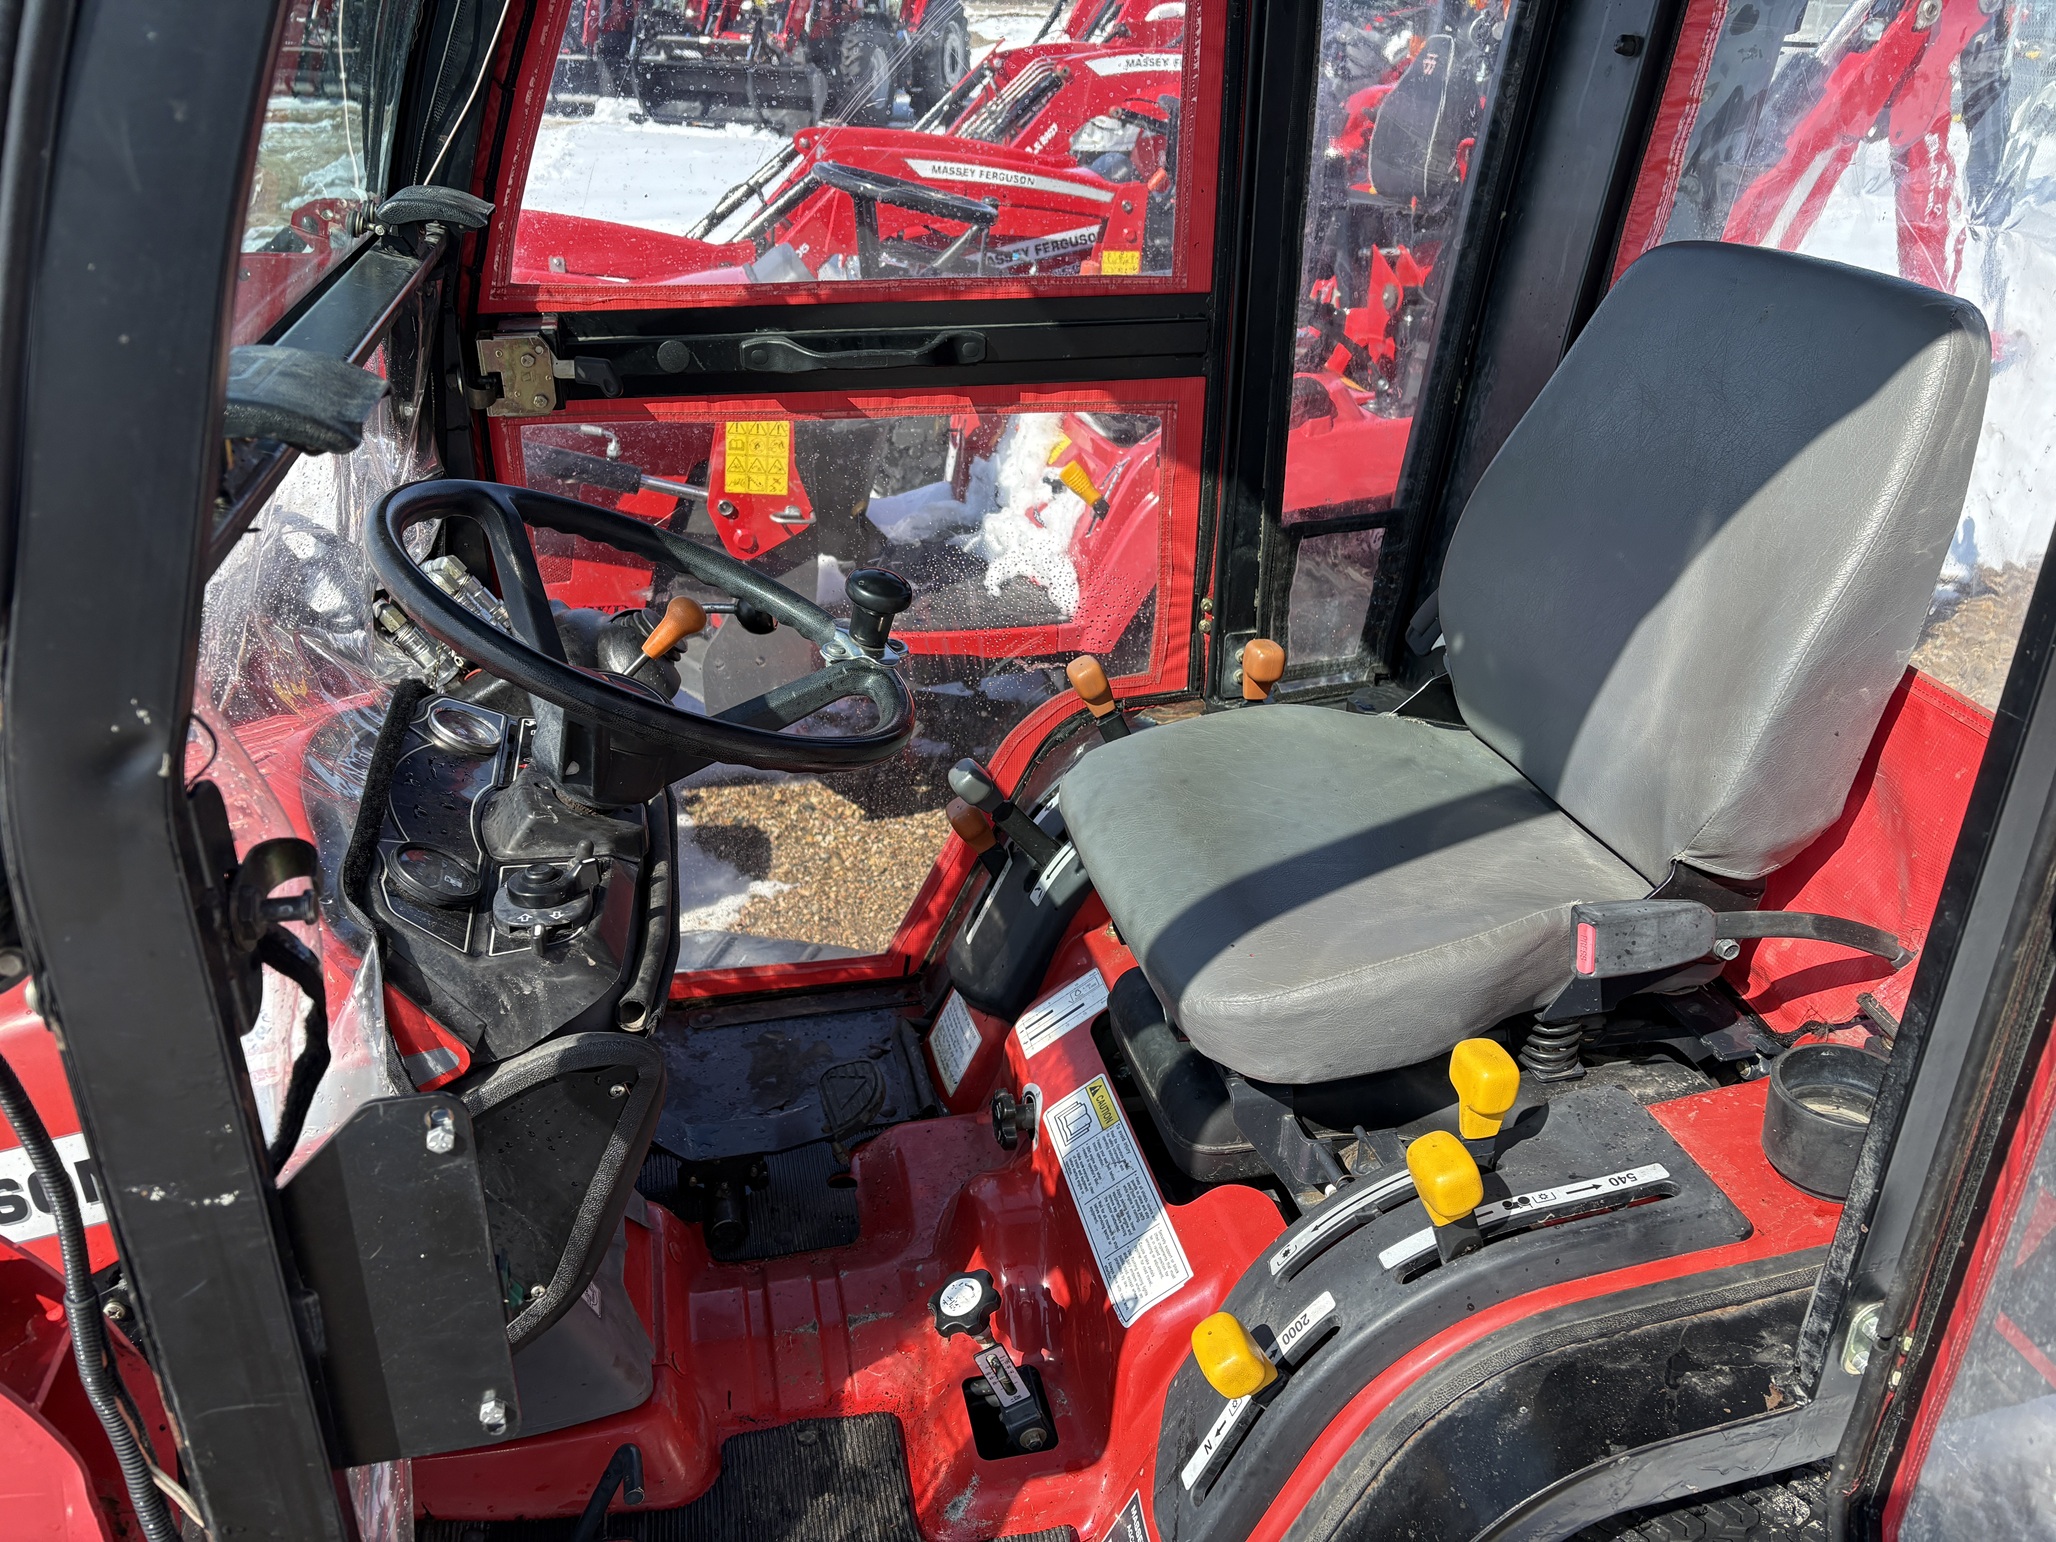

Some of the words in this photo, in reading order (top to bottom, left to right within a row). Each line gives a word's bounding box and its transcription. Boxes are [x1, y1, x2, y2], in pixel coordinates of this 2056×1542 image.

[1125, 58, 1169, 69] MASSEY
[931, 164, 977, 178] MASSEY
[979, 169, 1036, 187] FERGUSON
[1035, 231, 1098, 257] FERGUSO
[1095, 1094, 1114, 1124] CAUTION
[1608, 1172, 1638, 1187] 540
[1282, 1313, 1310, 1345] 2000
[1203, 1439, 1213, 1455] N
[1131, 1504, 1144, 1542] MASSE
